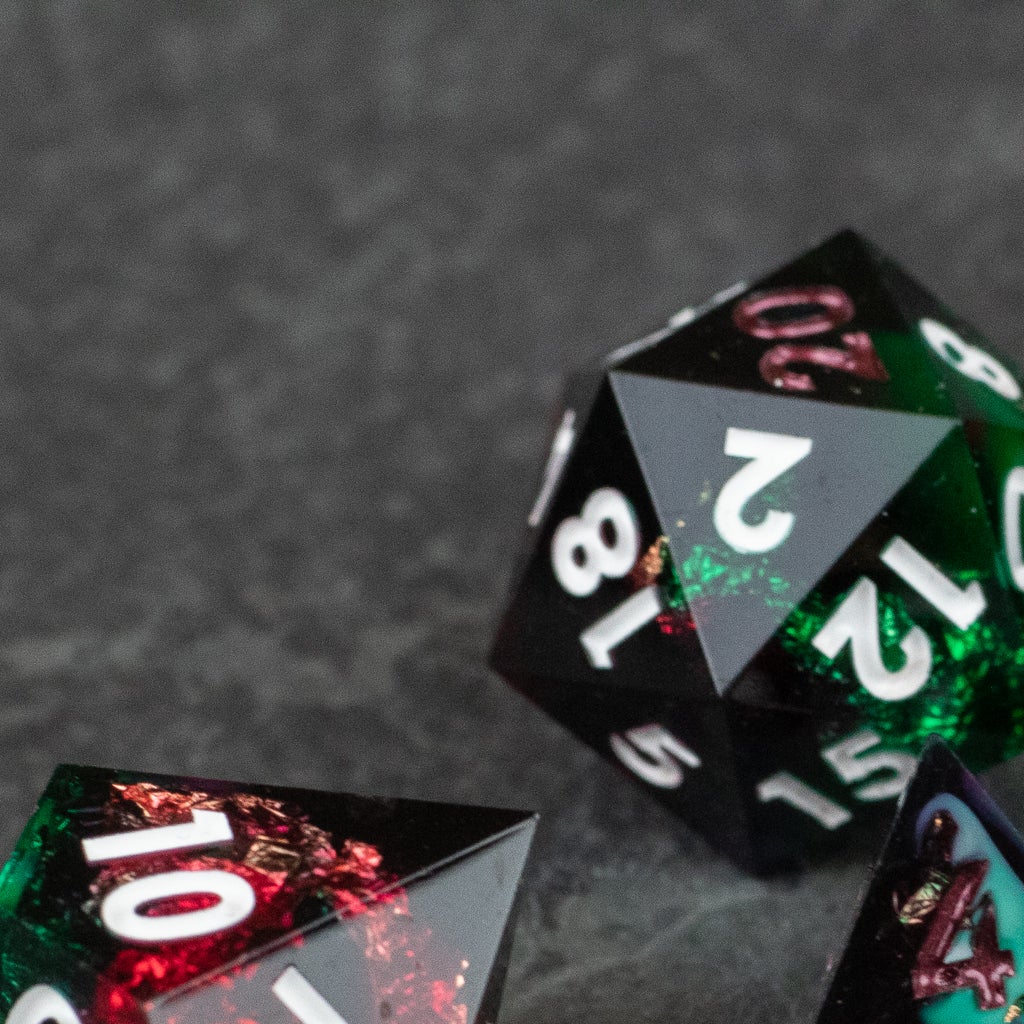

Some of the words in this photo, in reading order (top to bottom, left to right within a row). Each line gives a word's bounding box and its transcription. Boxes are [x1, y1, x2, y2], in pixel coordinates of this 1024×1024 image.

[732, 285, 890, 391] 20
[919, 318, 1022, 400] 8
[713, 427, 812, 553] 2
[550, 487, 662, 669] 18
[811, 536, 988, 702] 12
[609, 723, 701, 789] 5
[756, 730, 917, 830] 15
[81, 804, 257, 943] 10
[912, 858, 1015, 1010] 4
